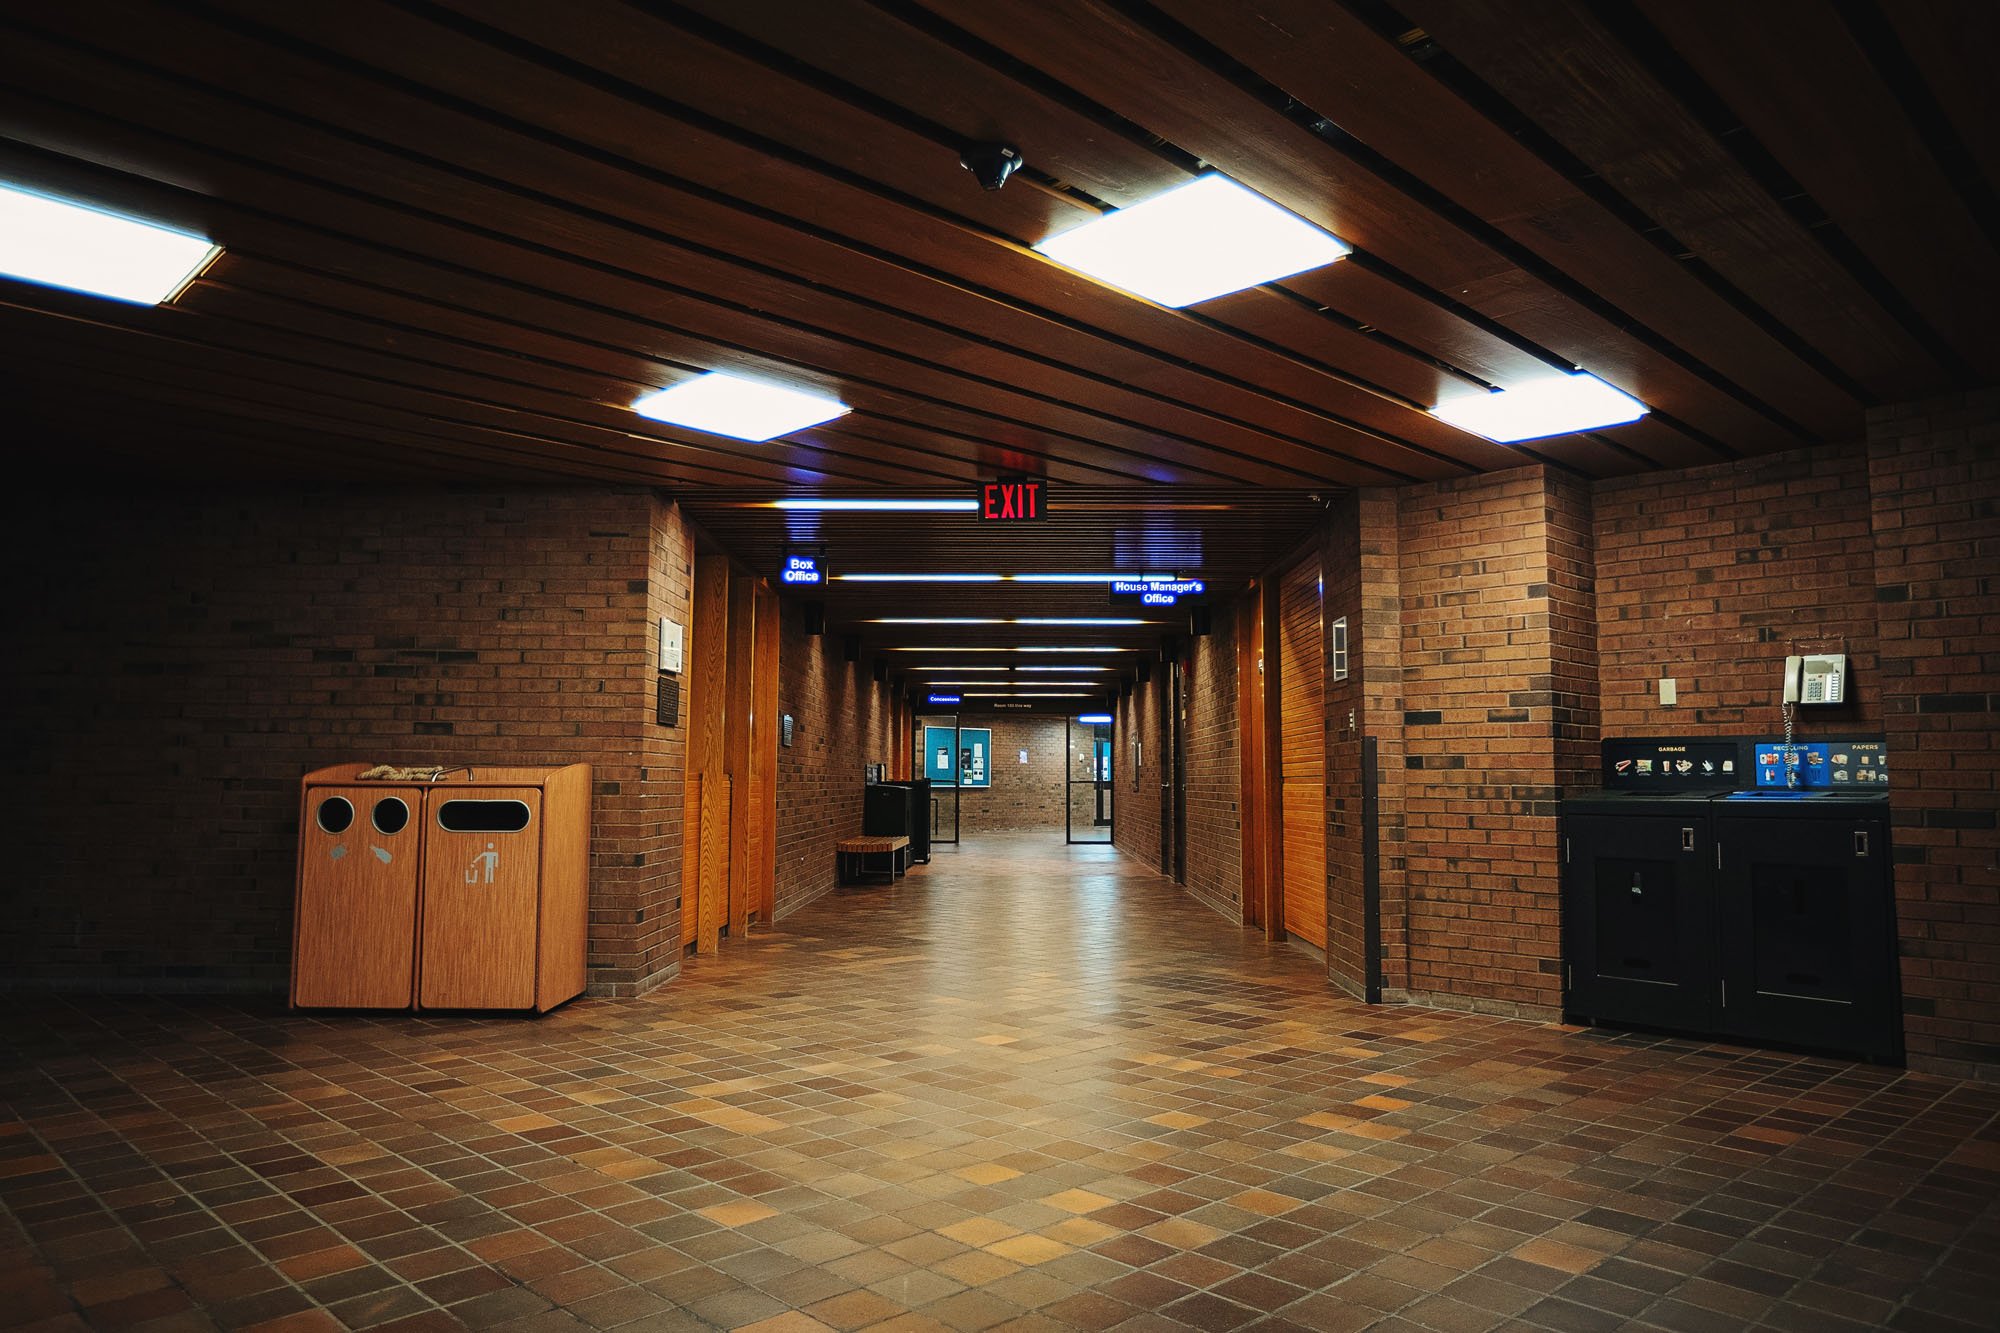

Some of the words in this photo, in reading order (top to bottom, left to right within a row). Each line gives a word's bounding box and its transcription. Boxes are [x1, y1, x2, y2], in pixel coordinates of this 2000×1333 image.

[984, 484, 1039, 519] EXIT
[790, 558, 814, 569] Box
[785, 570, 819, 581] Office
[1115, 581, 1148, 592] House
[1150, 581, 1203, 593] Manager's
[1143, 593, 1174, 603] Office
